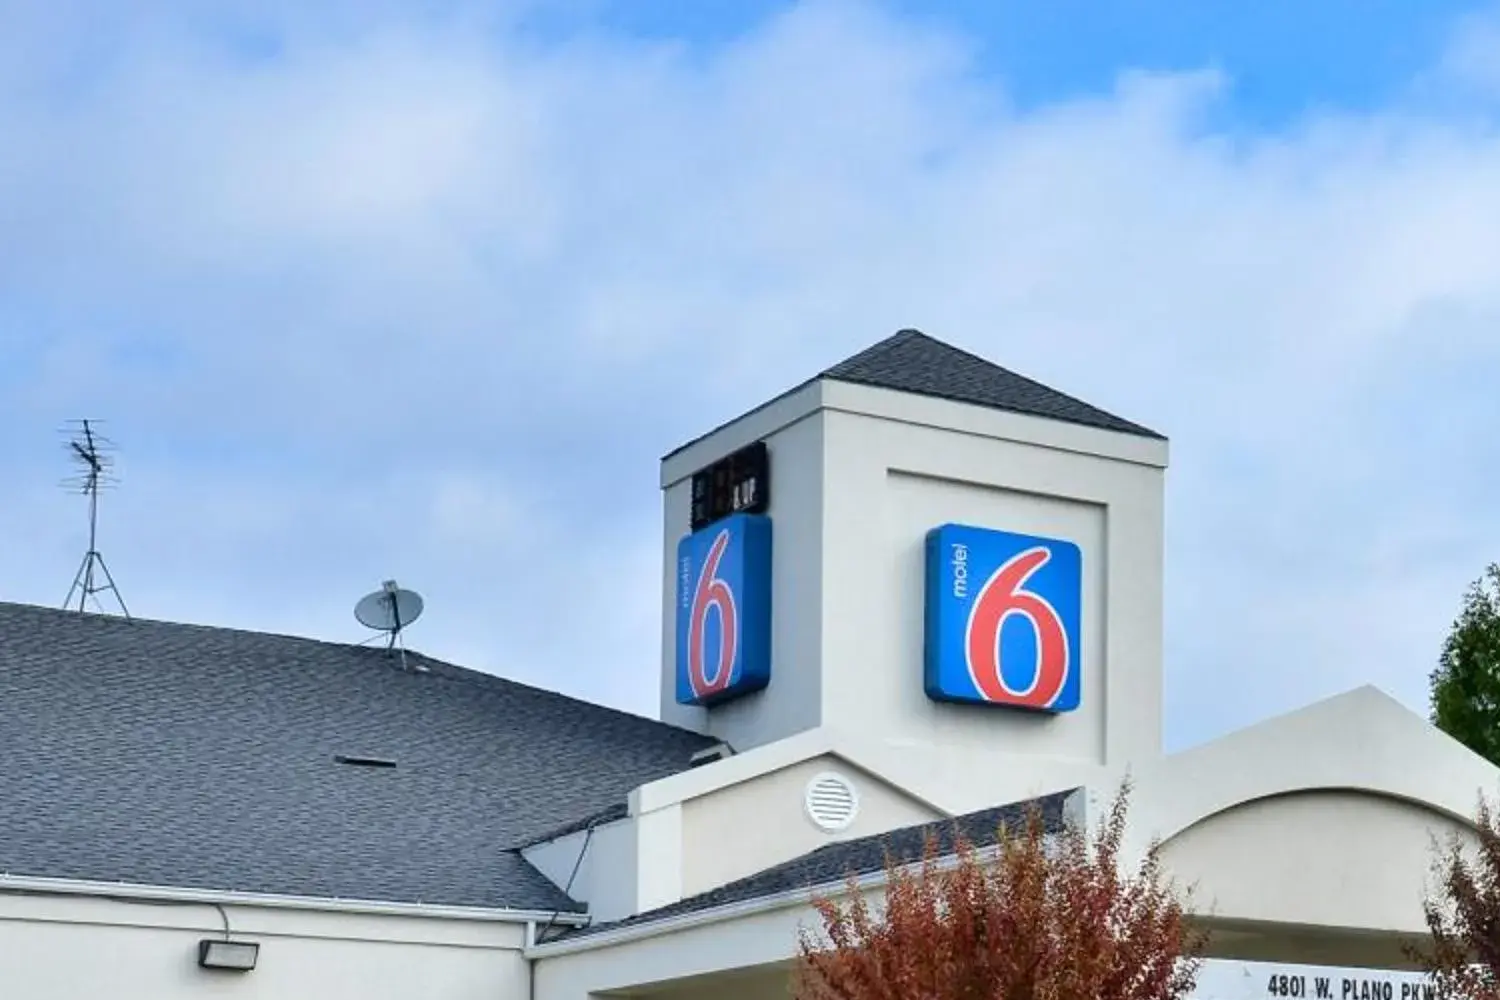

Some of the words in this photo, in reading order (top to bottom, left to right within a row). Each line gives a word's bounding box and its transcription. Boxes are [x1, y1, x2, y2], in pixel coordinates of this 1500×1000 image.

[688, 527, 738, 697] 6
[951, 543, 969, 598] motel
[964, 545, 1070, 708] 6
[1267, 975, 1306, 998] 4801
[1315, 977, 1334, 1000] W.
